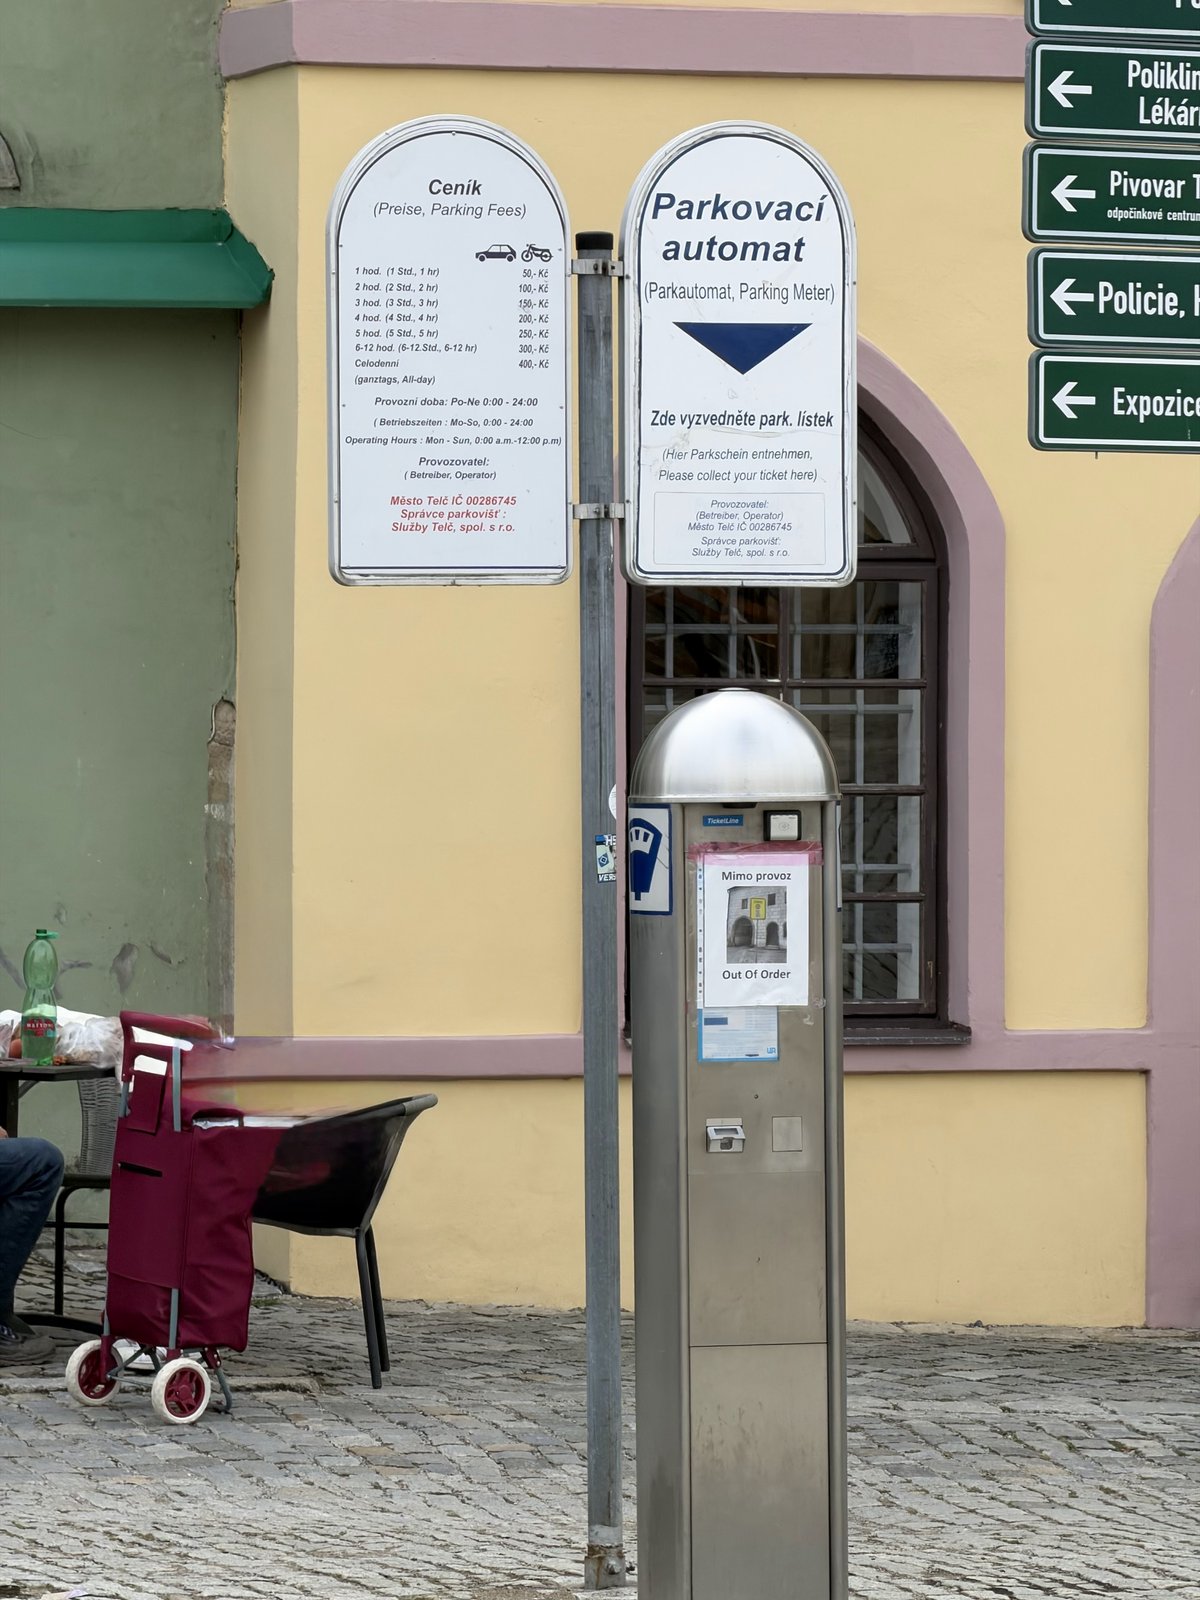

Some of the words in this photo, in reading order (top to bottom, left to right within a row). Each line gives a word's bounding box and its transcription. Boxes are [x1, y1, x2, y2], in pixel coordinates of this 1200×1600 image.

[1139, 96, 1200, 127] Lékár
[429, 179, 482, 195] Ceník
[1109, 170, 1186, 199] Pivovar
[373, 202, 425, 218] (Preise,
[431, 203, 483, 219] Parking
[487, 203, 526, 220] Fees)
[652, 193, 828, 222] Parkovací
[1107, 206, 1163, 222] odpočinkové
[662, 235, 806, 262] automat
[355, 267, 359, 275] 1
[362, 267, 381, 275] hod.
[387, 267, 395, 277] (1
[397, 267, 417, 277] Std.,
[420, 267, 424, 275] 1
[427, 267, 440, 277] hr)
[522, 269, 536, 279] 50,-
[538, 269, 549, 278] Kč
[355, 282, 360, 291] 2
[362, 283, 381, 291] hod.
[385, 283, 394, 293] (2
[396, 283, 416, 293] Std.,
[419, 283, 424, 292] 2
[426, 283, 438, 294] hr)
[519, 284, 536, 294] 100,-
[538, 284, 548, 293] Kč
[644, 282, 735, 303] (Parkautomat,
[740, 282, 789, 305] Parking
[793, 283, 835, 305] Meter)
[355, 298, 360, 307] 3
[362, 298, 381, 307] hod.
[385, 298, 394, 308] (3
[396, 298, 416, 308] Std.,
[419, 298, 424, 307] 3
[426, 298, 438, 309] hr)
[519, 299, 537, 309] 150,-
[538, 299, 549, 308] Kč
[1098, 281, 1186, 319] Policie,
[362, 313, 381, 322] hod.
[385, 313, 394, 323] (4
[396, 313, 416, 323] Std.,
[418, 314, 424, 322] 4
[426, 313, 438, 324] hr)
[518, 314, 537, 324] 200,-
[538, 314, 549, 323] Kč
[355, 329, 361, 337] 5
[362, 329, 382, 337] hod.
[386, 329, 394, 339] (5
[396, 329, 416, 338] Std.,
[419, 329, 424, 337] 5
[426, 329, 439, 339] hr)
[519, 329, 537, 339] 250,-
[538, 329, 549, 339] Kč
[355, 343, 374, 352] 6-12
[376, 343, 395, 352] hod.
[398, 343, 441, 353] (6-12.Std.,
[444, 343, 463, 352] 6-12
[465, 344, 477, 354] hr)
[518, 344, 537, 354] 300,-
[538, 344, 549, 353] Kč
[518, 359, 537, 369] 400,-
[538, 359, 549, 369] Kč
[354, 375, 400, 385] (ganztags,
[401, 375, 435, 386] All-day)
[420, 397, 448, 406] doba:
[450, 397, 480, 406] Po-Ne
[483, 397, 503, 406] 0:00
[512, 398, 538, 406] 24:00
[379, 418, 442, 426] Betriebszeiten
[450, 418, 480, 427] Mo-So,
[483, 418, 502, 427] 0:00
[510, 418, 533, 427] 24:00
[650, 410, 676, 426] Zde
[680, 410, 756, 429] vyzvedněte
[759, 411, 792, 430] park.
[797, 410, 834, 427] lístek
[345, 436, 389, 446] Operating
[391, 436, 417, 444] Hours
[425, 436, 444, 444] Mon
[452, 436, 472, 445] Sun,
[474, 436, 494, 444] 0:00
[542, 437, 562, 446] p.m)
[690, 448, 748, 460] Parkschein
[751, 448, 813, 460] entnehmen,
[418, 457, 489, 466] Provozovatel:
[410, 471, 452, 480] Betreiber,
[455, 471, 496, 480] Operator)
[658, 469, 694, 481] Please
[697, 469, 731, 481] collect
[733, 472, 757, 484] your
[760, 469, 788, 481] ticket
[790, 469, 817, 483] here)
[390, 496, 423, 505] Město
[427, 496, 448, 506] Telč
[451, 494, 463, 505] IČ
[466, 496, 517, 506] 00286745
[710, 499, 769, 509] Provozovatel:
[400, 509, 445, 521] Správce
[696, 511, 739, 521] (Betreiber,
[743, 511, 784, 522] Operator)
[391, 522, 428, 534] Služby
[432, 522, 456, 533] Telč,
[459, 522, 485, 534] spol.
[489, 524, 495, 532] s
[498, 524, 515, 532] r.o.
[688, 522, 714, 531] Město
[737, 521, 747, 531] IČ
[749, 522, 792, 531] 00286745
[701, 536, 737, 547] Správce
[692, 547, 722, 558] Služby
[746, 548, 766, 559] spol.
[722, 871, 753, 880] Mimo
[756, 873, 791, 882] provoz
[722, 970, 742, 980] Out
[745, 969, 758, 979] Of
[760, 969, 791, 979] Order
